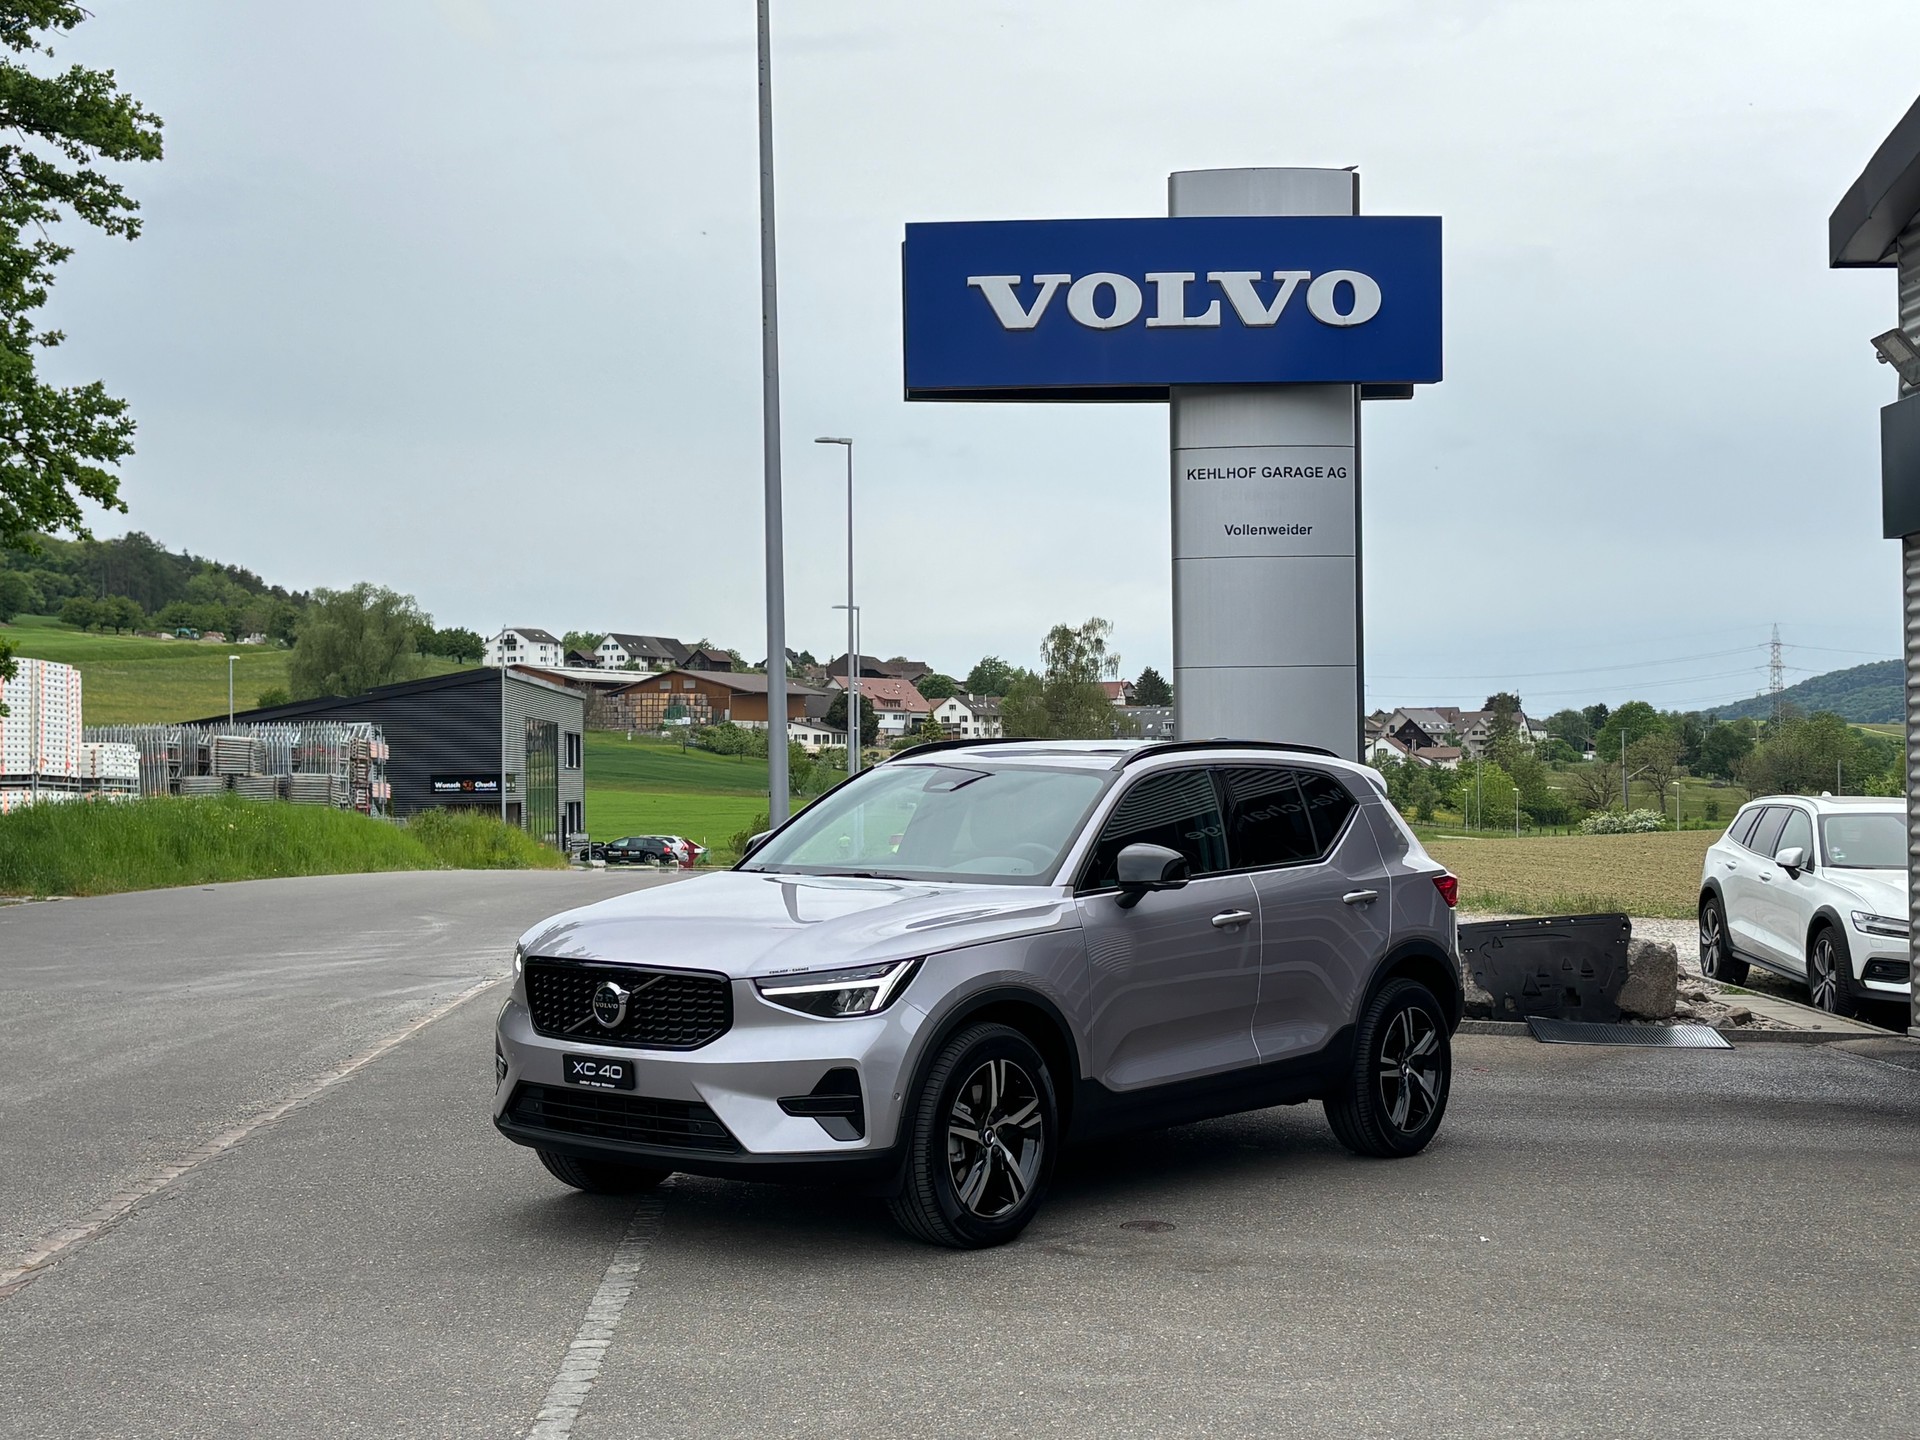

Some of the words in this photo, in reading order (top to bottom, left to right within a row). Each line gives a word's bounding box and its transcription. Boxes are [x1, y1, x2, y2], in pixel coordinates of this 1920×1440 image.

[967, 270, 1382, 329] VOLVO
[1187, 467, 1257, 480] KEHLHOF
[1261, 466, 1324, 479] GARAGE
[1327, 466, 1347, 479] AG
[1224, 524, 1313, 536] Vollenweider
[572, 1061, 596, 1075] XC
[598, 1065, 623, 1079] 40
